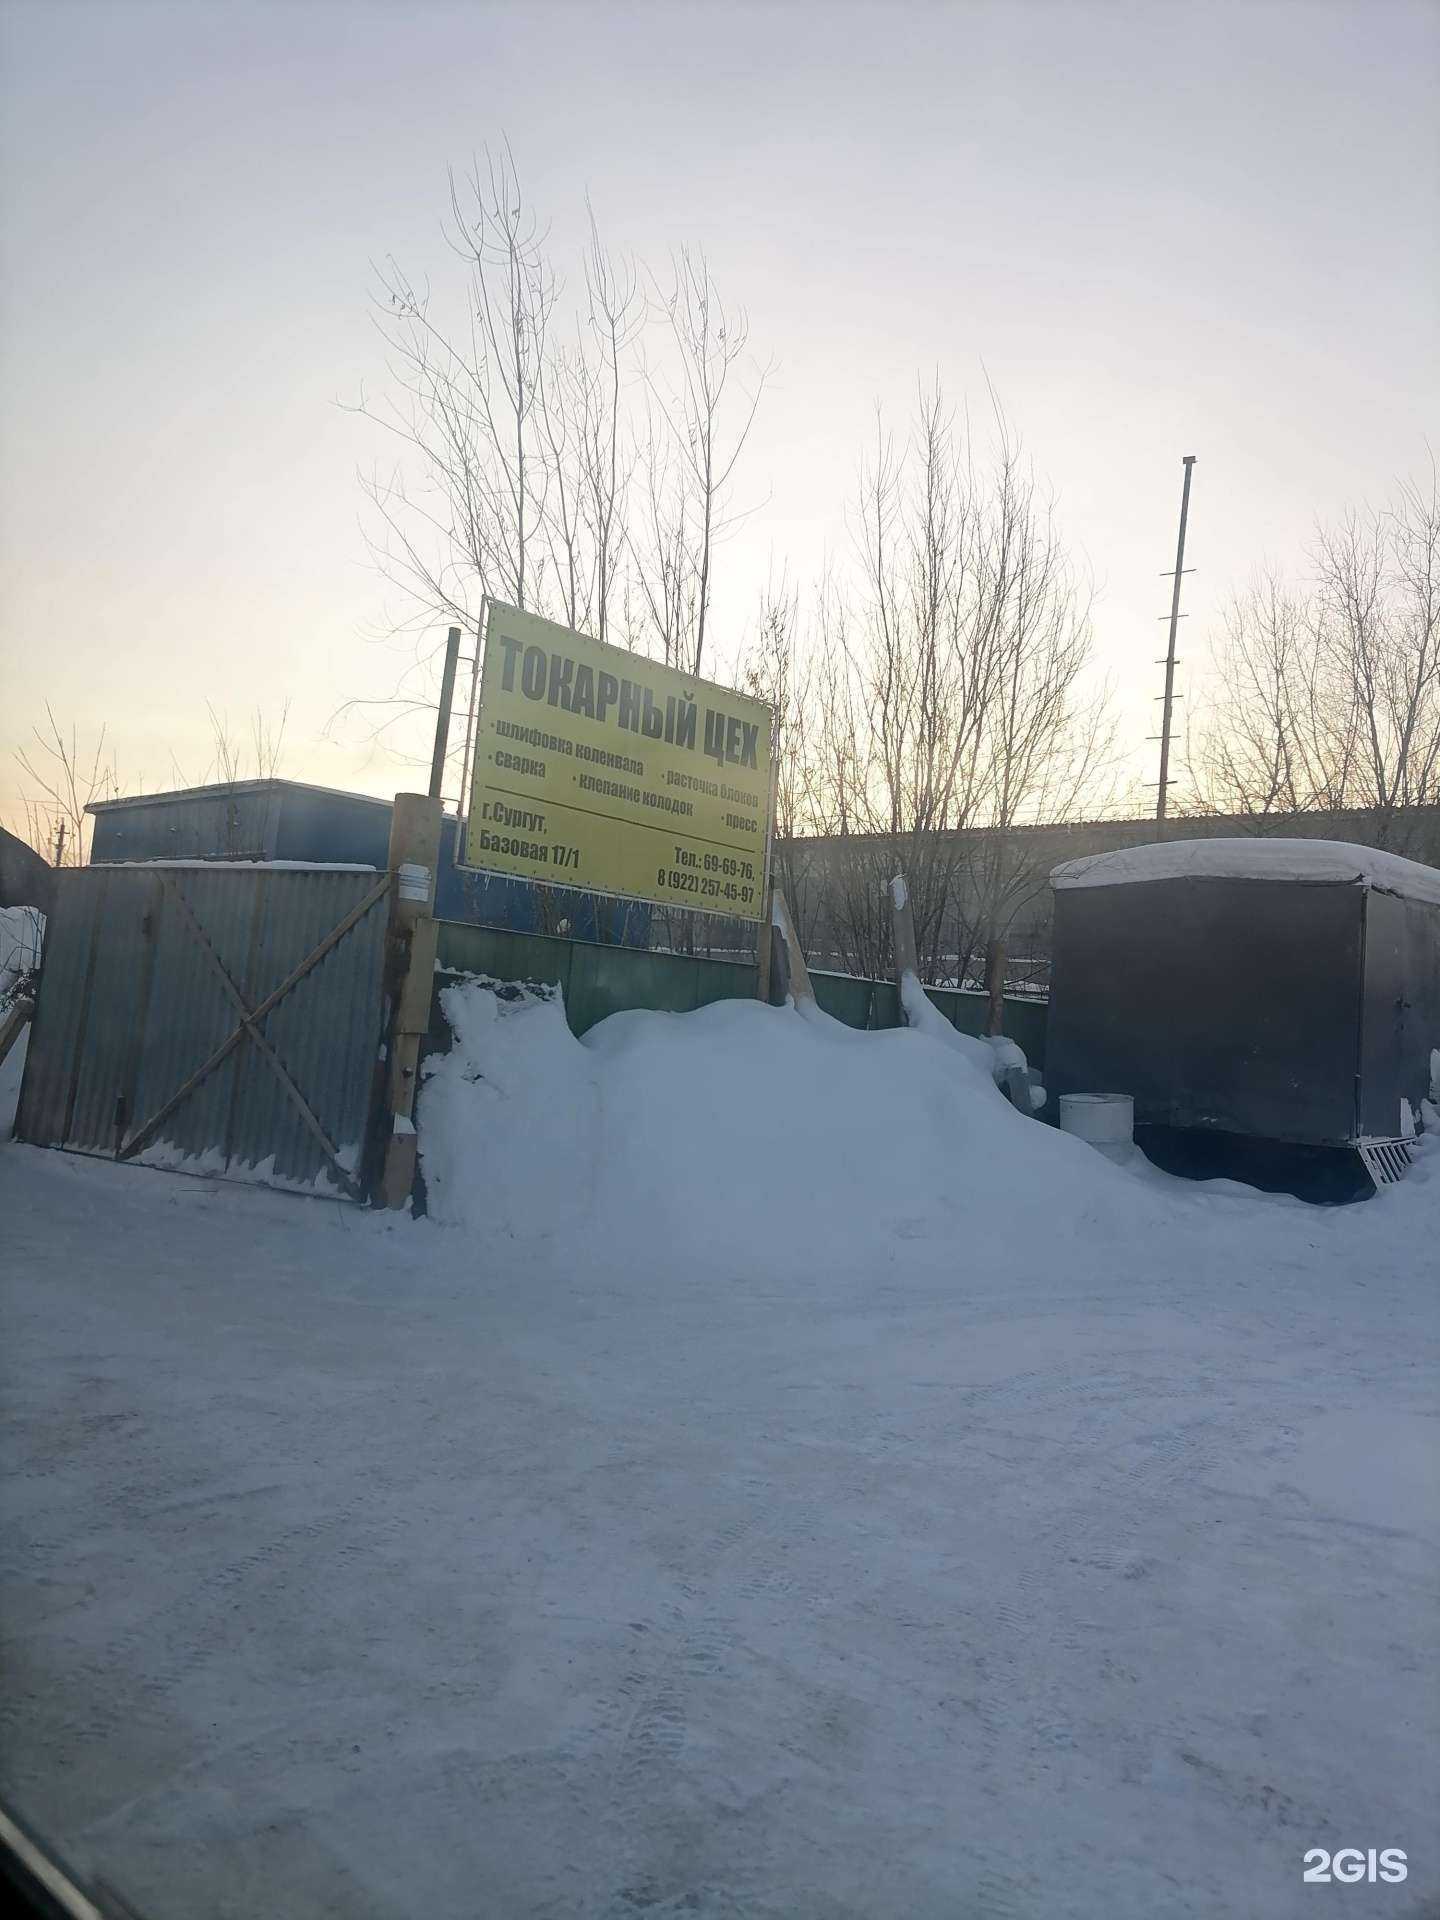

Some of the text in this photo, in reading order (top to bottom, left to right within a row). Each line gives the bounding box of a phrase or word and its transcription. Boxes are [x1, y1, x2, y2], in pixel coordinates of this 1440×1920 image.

[499, 635, 760, 770] ТОКАРНЫЙ ЦЕХ
[495, 720, 644, 776] шлифовка коленвала
[495, 750, 546, 778] сварка
[579, 773, 693, 816] клепание колодок
[666, 769, 759, 807] расточка блоков
[725, 815, 758, 833] пресс
[479, 830, 580, 869] Базовая 17/1
[674, 846, 755, 882] Тел.: 69-69-76,
[657, 868, 754, 903] 8 (922) 257-45-97
